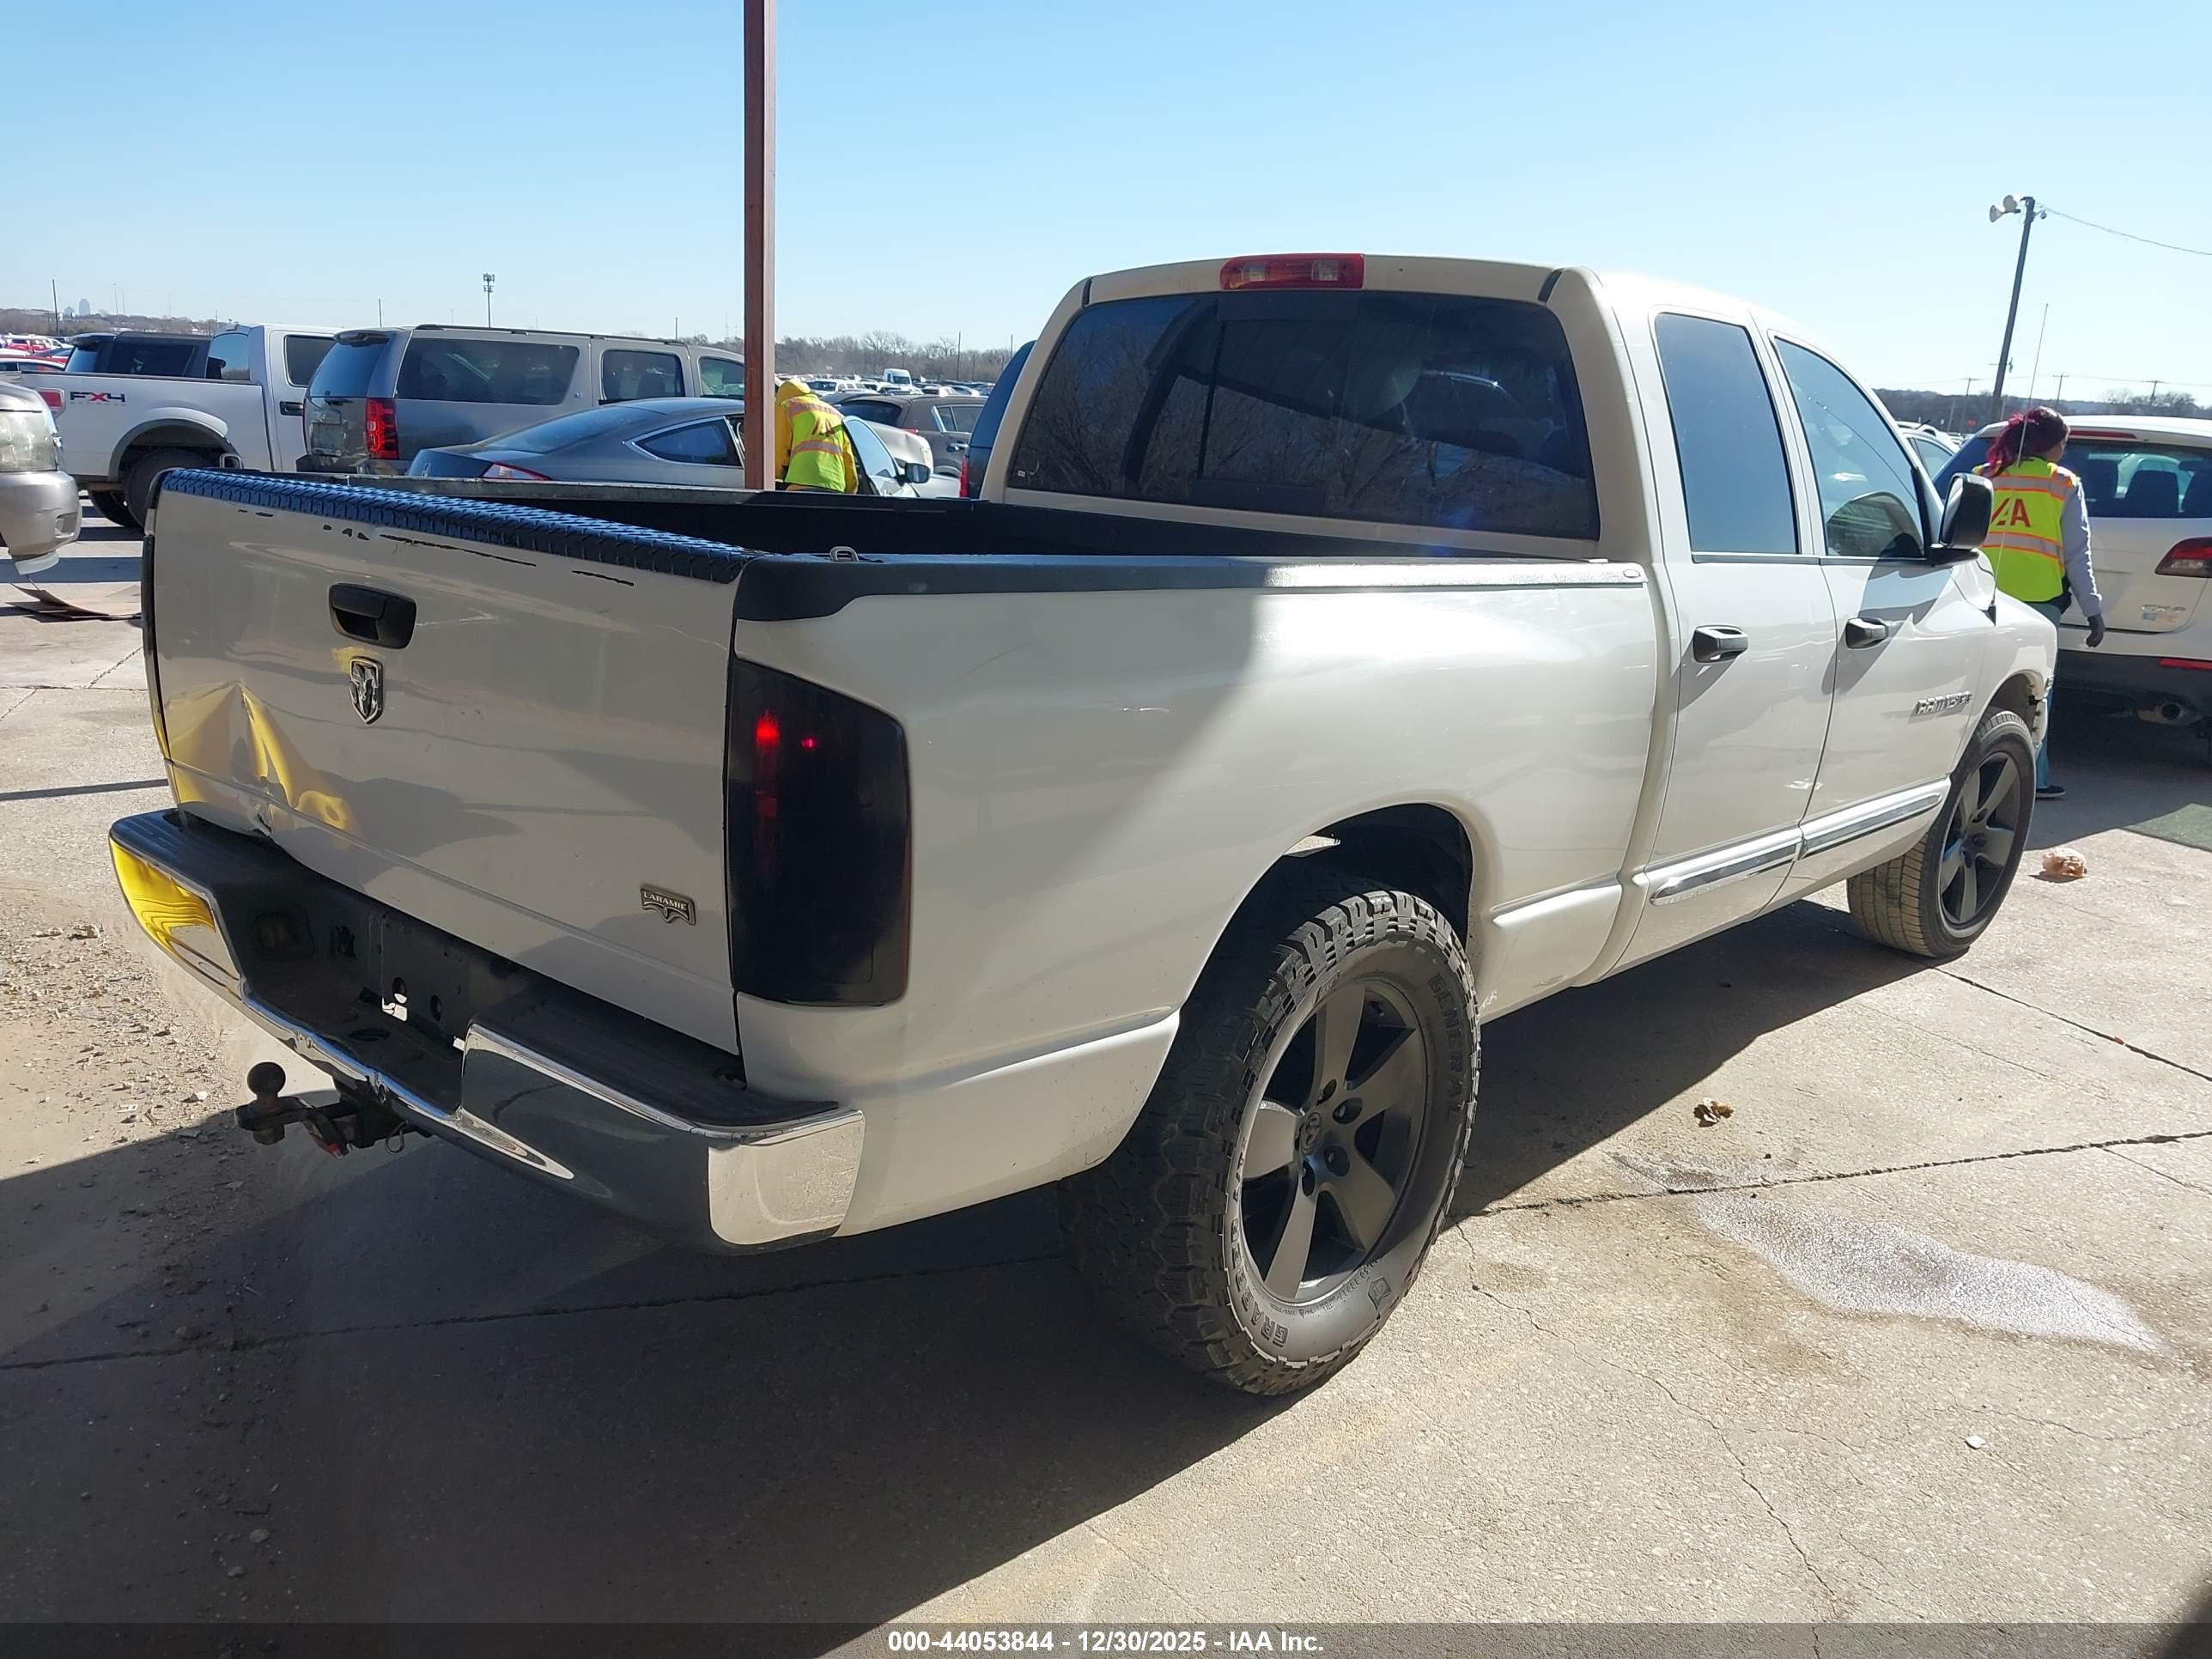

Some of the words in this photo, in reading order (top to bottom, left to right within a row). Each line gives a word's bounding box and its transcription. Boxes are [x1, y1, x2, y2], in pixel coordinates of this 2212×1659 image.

[70, 391, 126, 403] FX4
[642, 890, 689, 912] LARAMIE
[1427, 972, 1465, 1122] GENERAL
